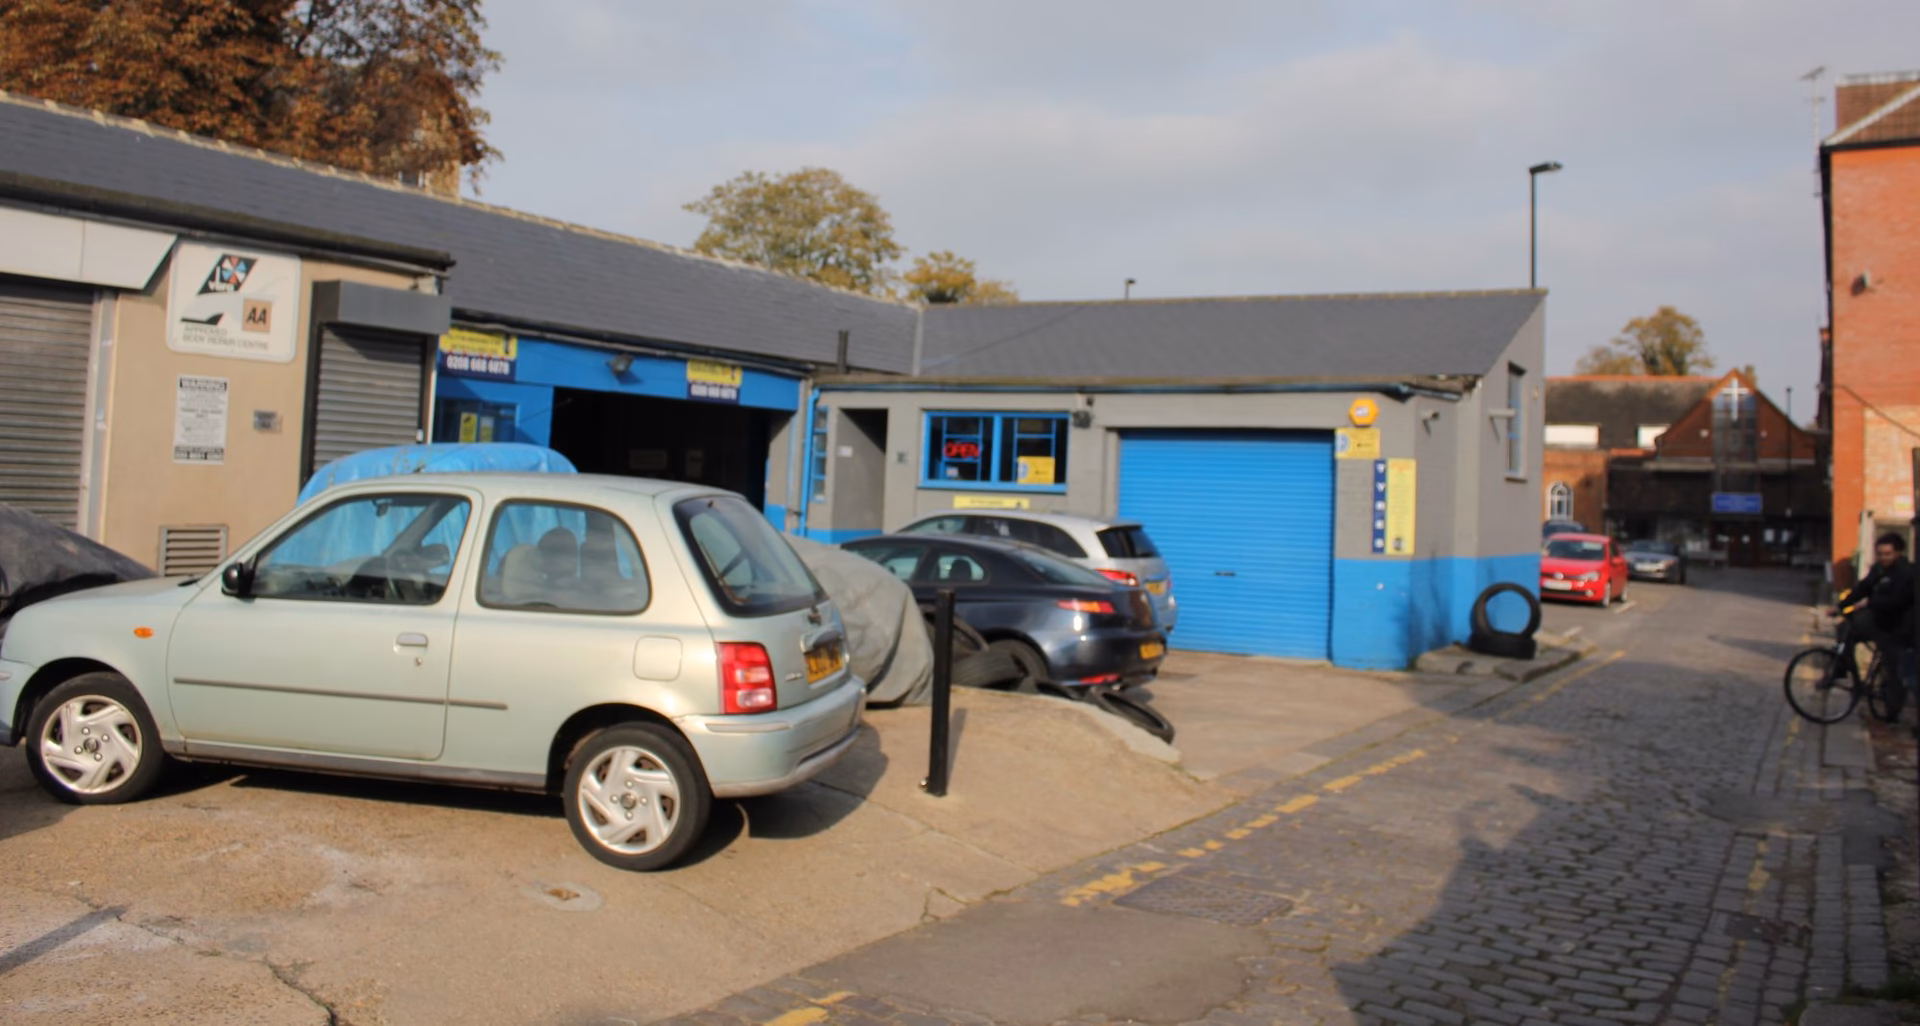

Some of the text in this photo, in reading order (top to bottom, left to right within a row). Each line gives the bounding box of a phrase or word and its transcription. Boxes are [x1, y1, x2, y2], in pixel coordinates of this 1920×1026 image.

[246, 306, 267, 325] AA
[184, 324, 228, 337] APPROVED
[182, 334, 270, 350] BODY REPAIR CENTRE
[944, 443, 979, 457] OPEN
